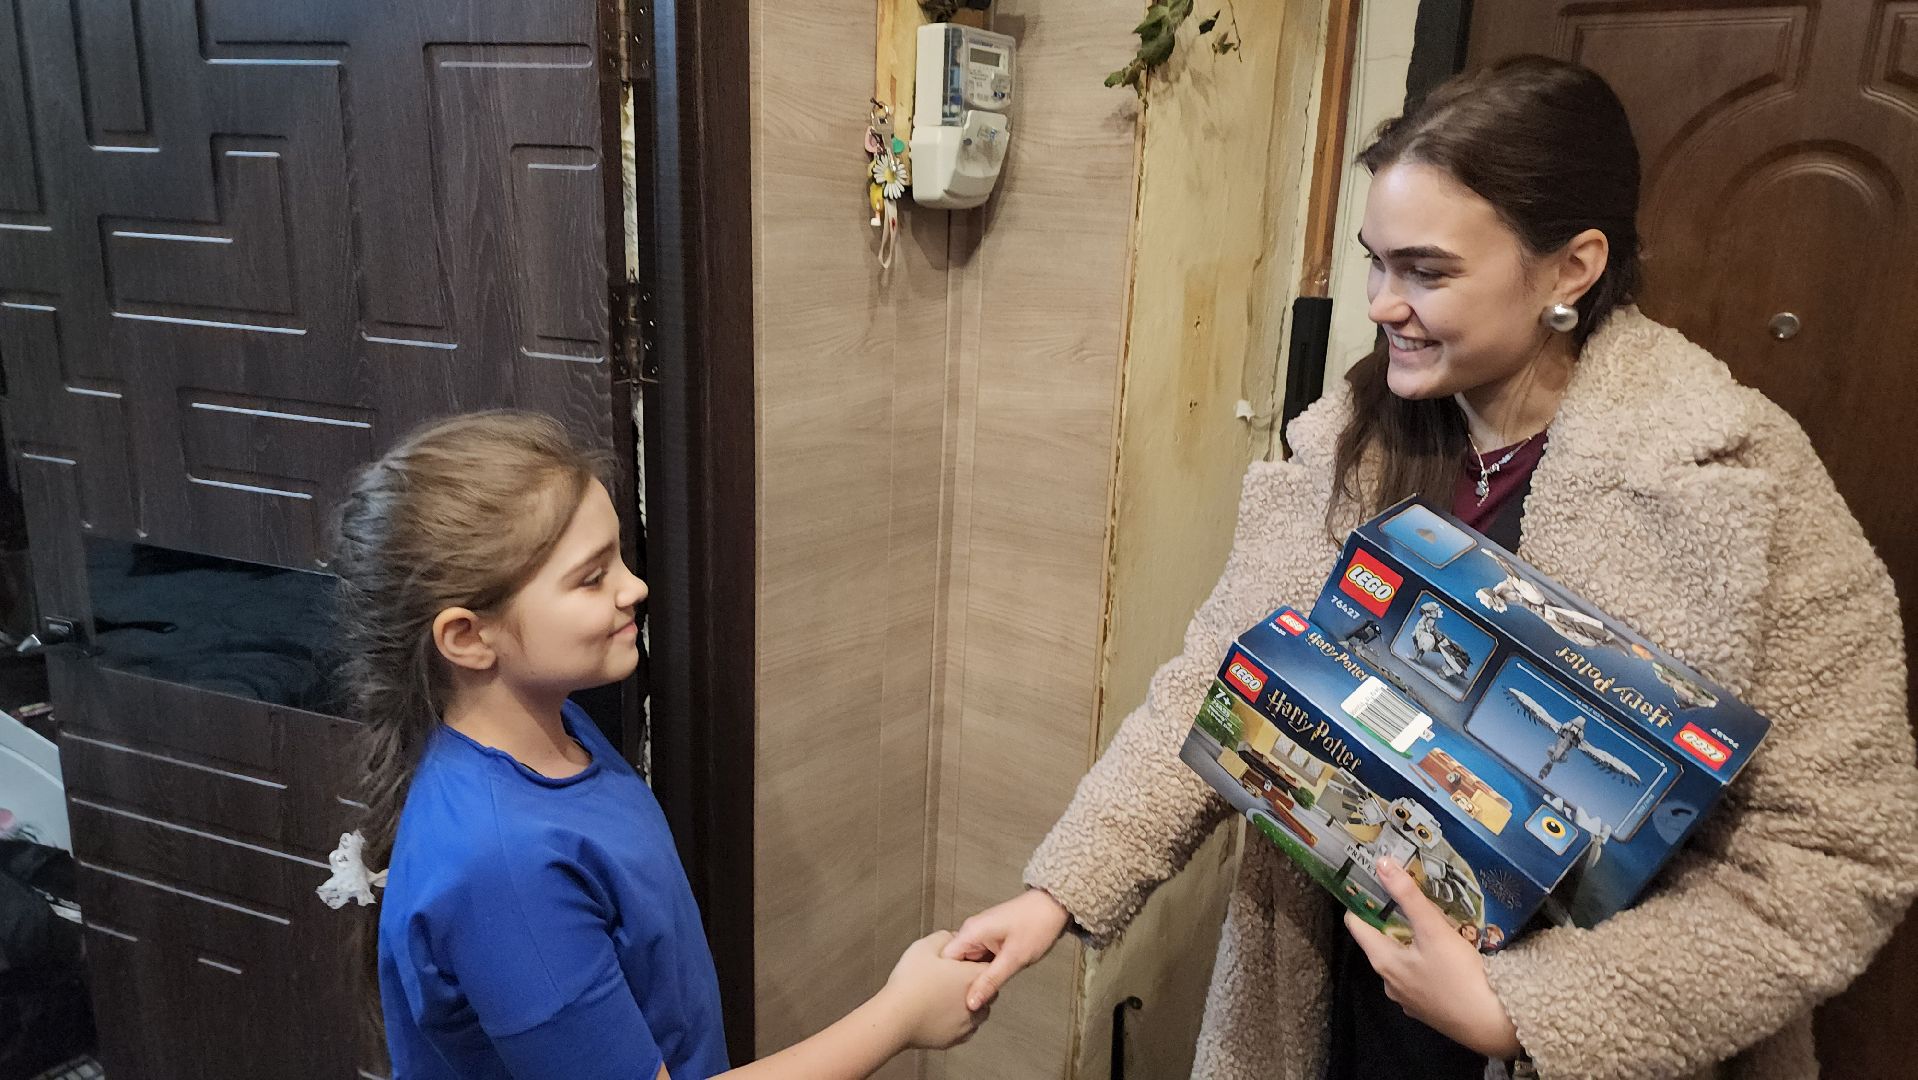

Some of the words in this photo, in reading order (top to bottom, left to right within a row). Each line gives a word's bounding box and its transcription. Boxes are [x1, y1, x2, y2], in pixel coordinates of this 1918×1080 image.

[1347, 564, 1394, 602] LEGO
[1331, 595, 1360, 619] 76427
[1305, 632, 1338, 656] Harry
[1335, 652, 1370, 681] Potter
[1555, 646, 1615, 695] Potter
[1215, 687, 1232, 706] 7+
[1230, 663, 1263, 692] LEGO
[1612, 687, 1673, 728] Harry
[1266, 688, 1314, 733] Harry
[1309, 719, 1362, 773] Potter
[1680, 730, 1727, 762] LEGO
